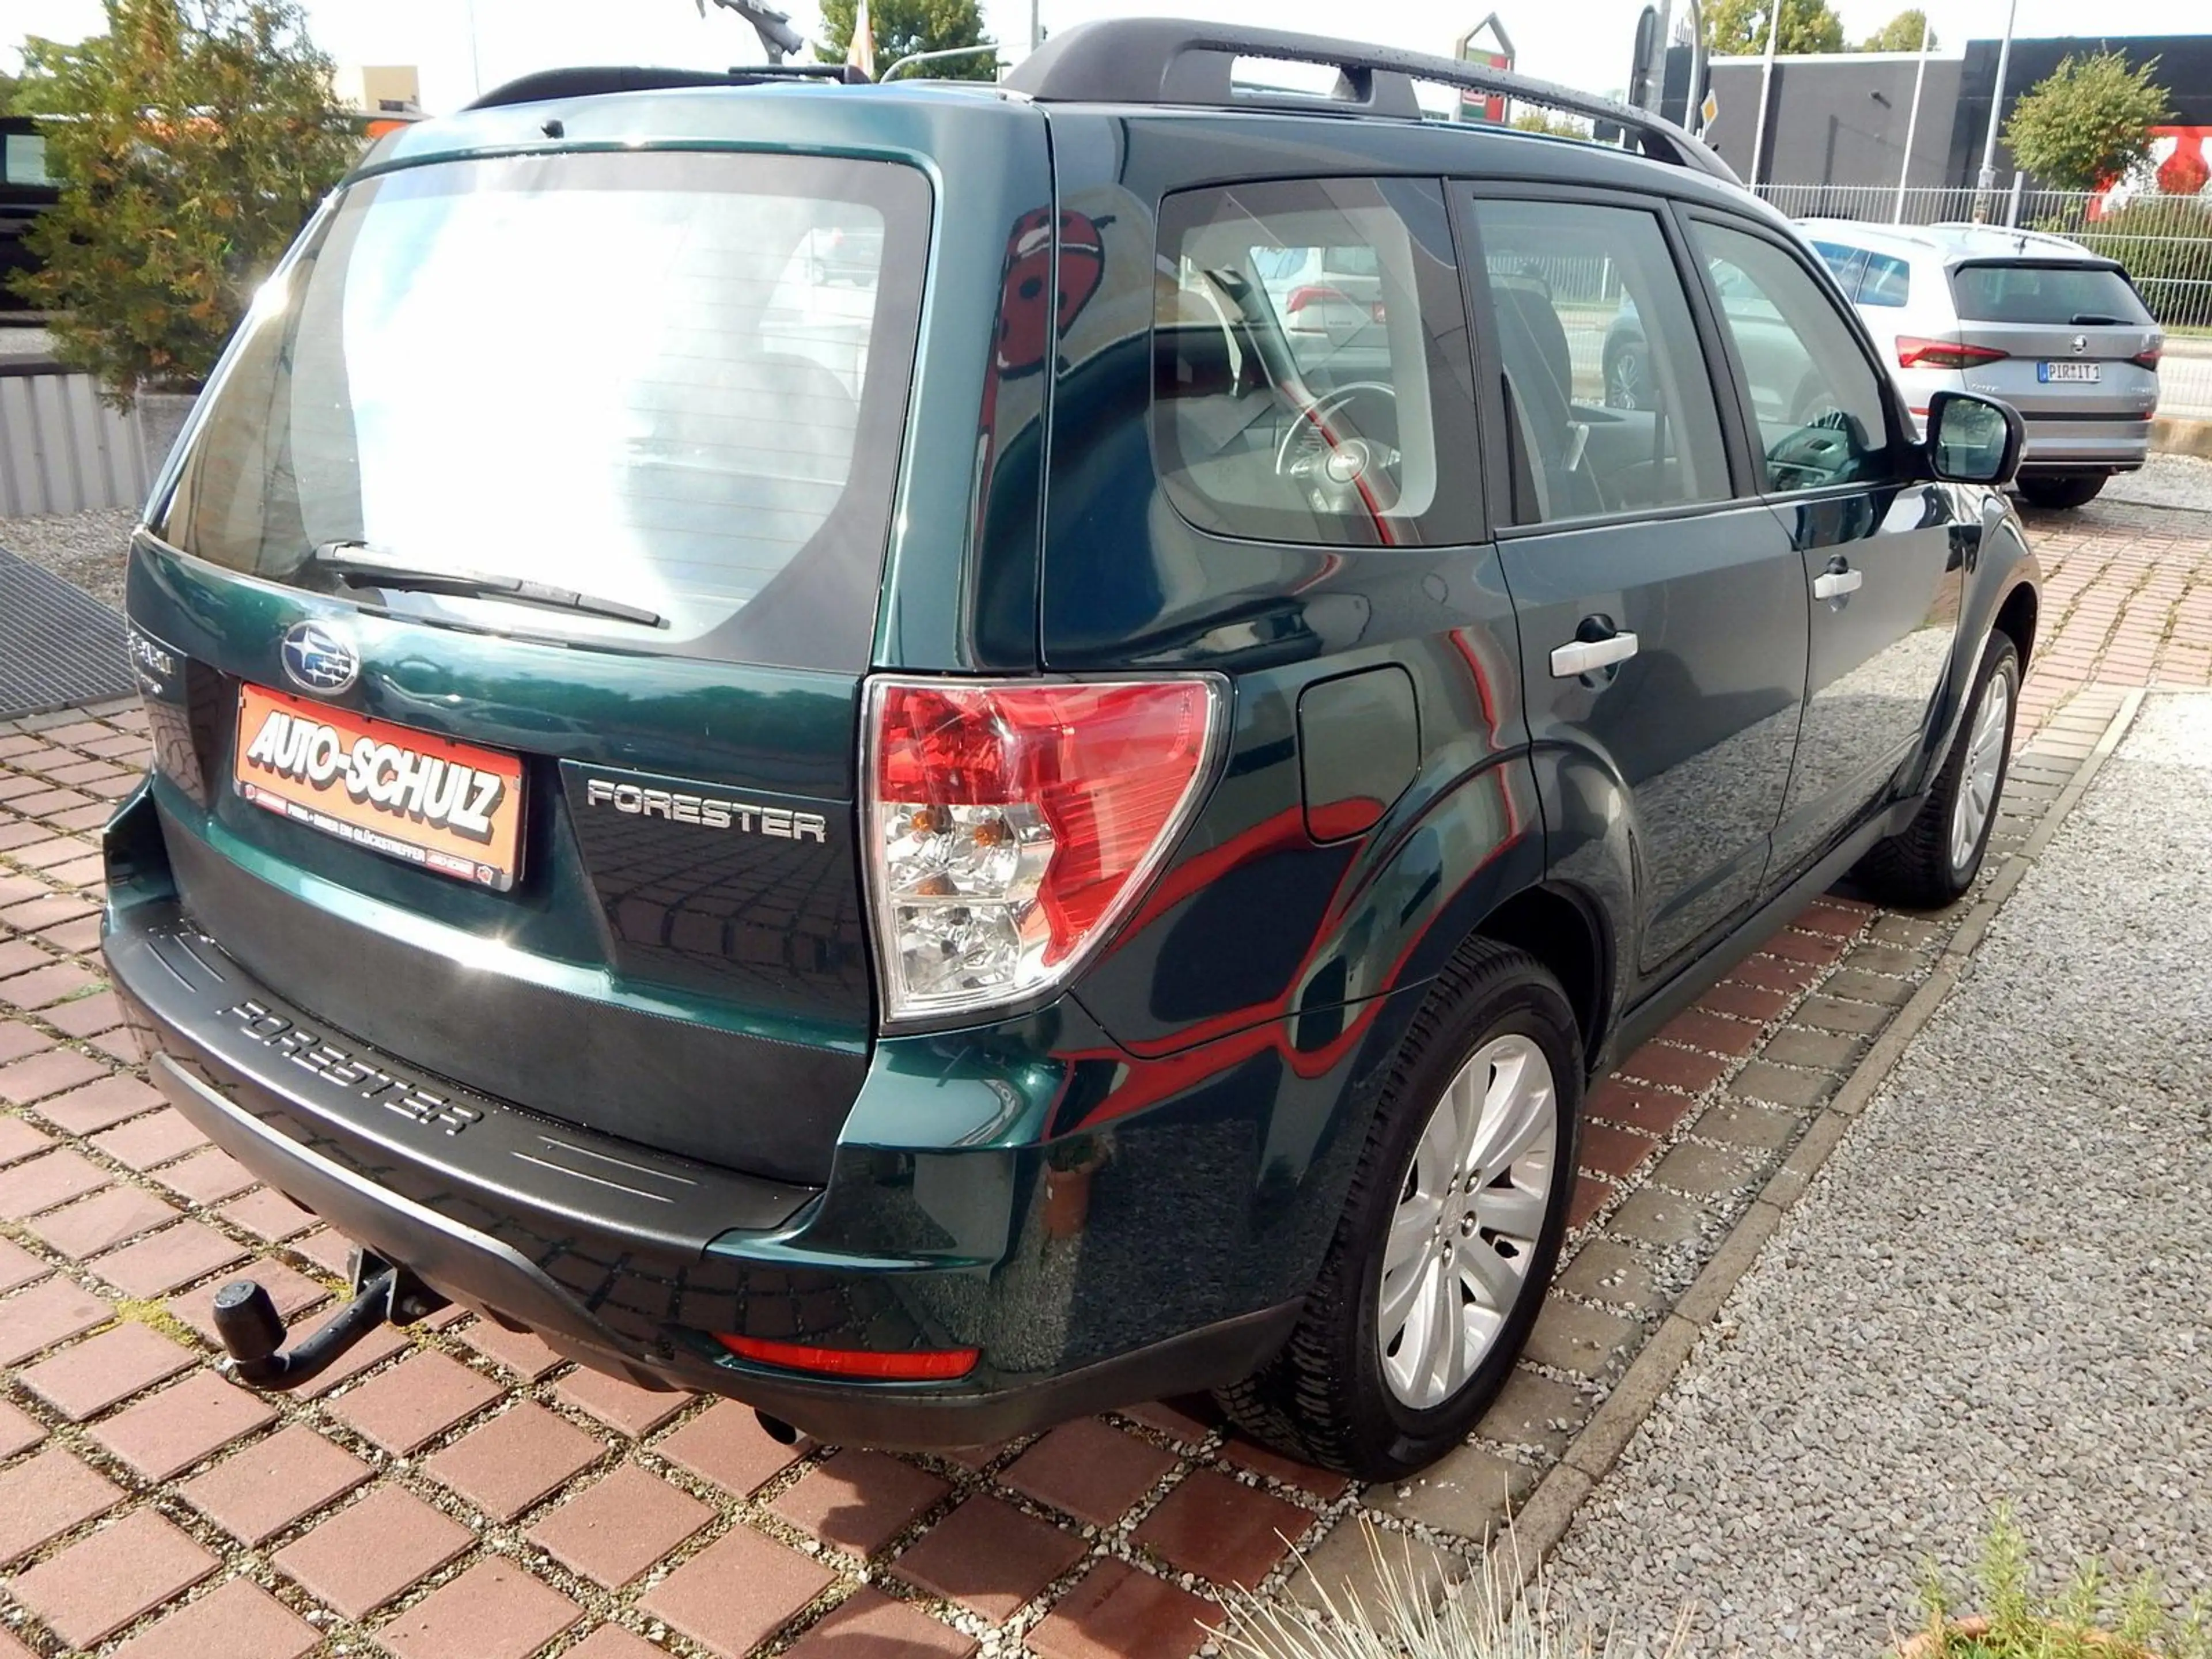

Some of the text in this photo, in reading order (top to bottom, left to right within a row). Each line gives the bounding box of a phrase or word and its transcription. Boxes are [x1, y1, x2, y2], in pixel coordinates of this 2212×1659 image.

[2049, 364, 2070, 378] PIR
[247, 710, 505, 845] AUTO-SCHULZ
[587, 779, 826, 843] FORESTER
[214, 998, 484, 1137] FORESTER
